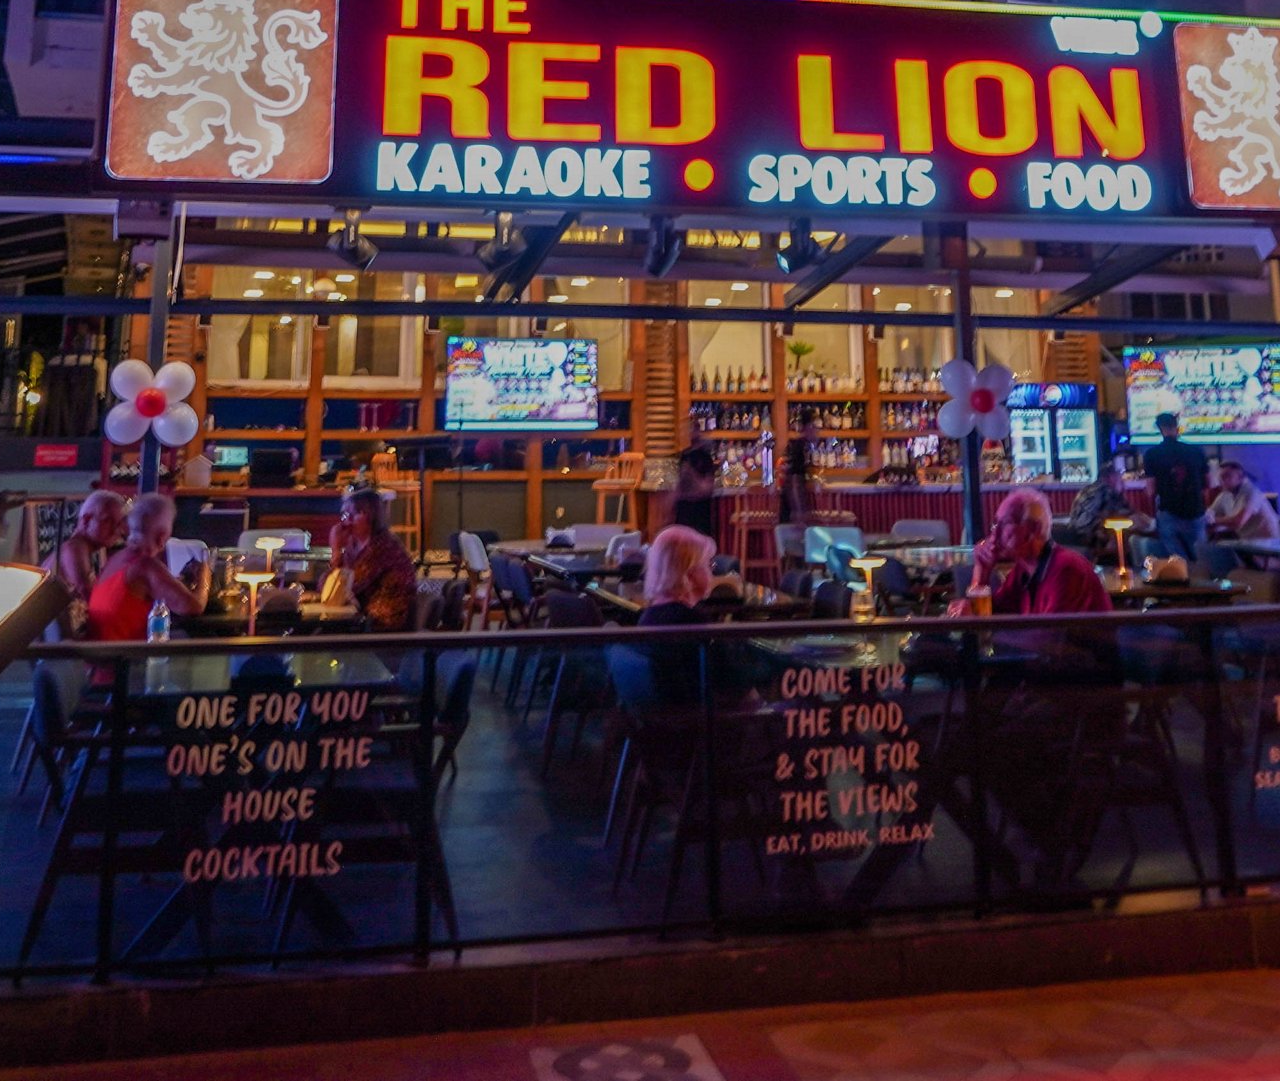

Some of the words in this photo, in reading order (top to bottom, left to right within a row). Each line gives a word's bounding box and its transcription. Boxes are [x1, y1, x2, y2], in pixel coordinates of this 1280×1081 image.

[382, 34, 717, 146] RED
[796, 53, 1146, 161] LION
[375, 141, 652, 199] KARAOKE
[747, 153, 937, 207] SPORTS
[1026, 161, 1152, 212] FOOD
[781, 666, 851, 699] COME
[860, 661, 907, 694] FOR
[175, 694, 238, 730] ONE
[248, 691, 302, 726] FOR
[310, 689, 370, 724] YOU
[784, 706, 832, 739] THE
[840, 701, 910, 736] FOOD,
[166, 734, 257, 777] ONE'S
[265, 739, 308, 773] ON
[320, 736, 373, 771] THE
[775, 752, 796, 781] &
[804, 744, 866, 780] STAY
[874, 740, 921, 774] FOR
[223, 787, 317, 825] HOUSE
[781, 790, 830, 822] THE
[837, 780, 920, 818] VIEWS
[766, 833, 807, 855] EAT,
[879, 823, 935, 845] RELAX
[183, 840, 344, 884] COCKTAILS
